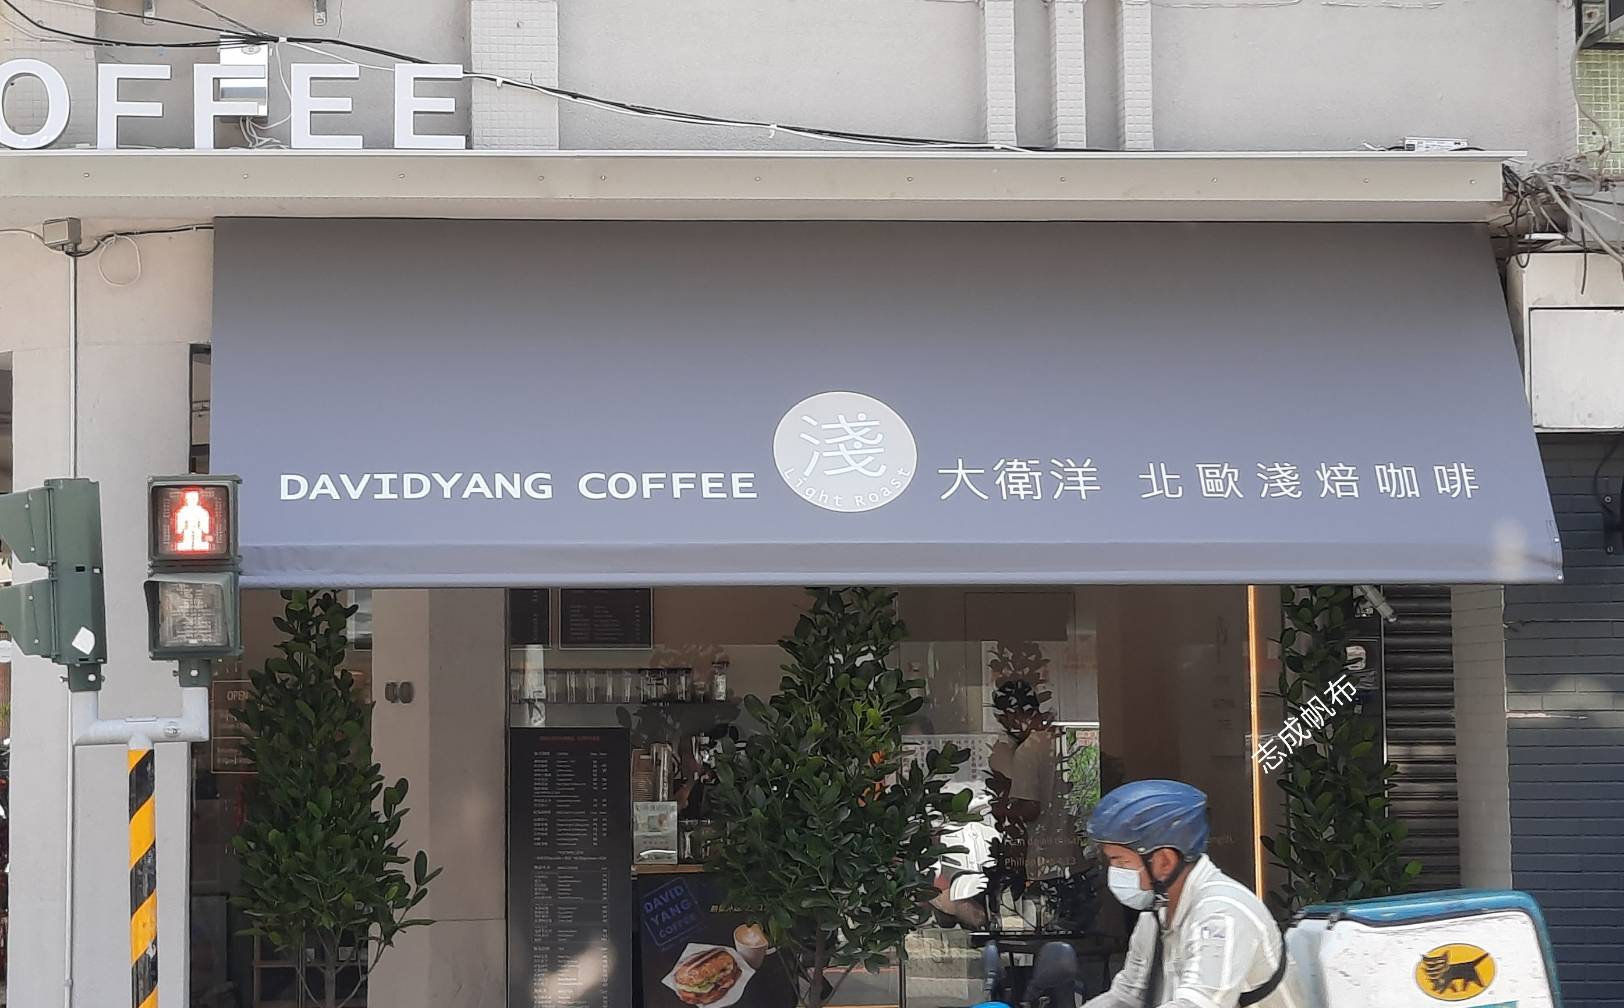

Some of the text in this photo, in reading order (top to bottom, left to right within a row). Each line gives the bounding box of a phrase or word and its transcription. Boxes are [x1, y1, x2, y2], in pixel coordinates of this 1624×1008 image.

[0, 58, 467, 149] OFFEE
[799, 412, 887, 478] 淺
[279, 472, 758, 500] DAVIDYANG COFFEE
[784, 466, 911, 507] Light Roast
[937, 458, 1480, 501] 大衛洋 北歐淺焙咖啡
[643, 885, 685, 914] DAVID
[650, 899, 692, 927] YANG
